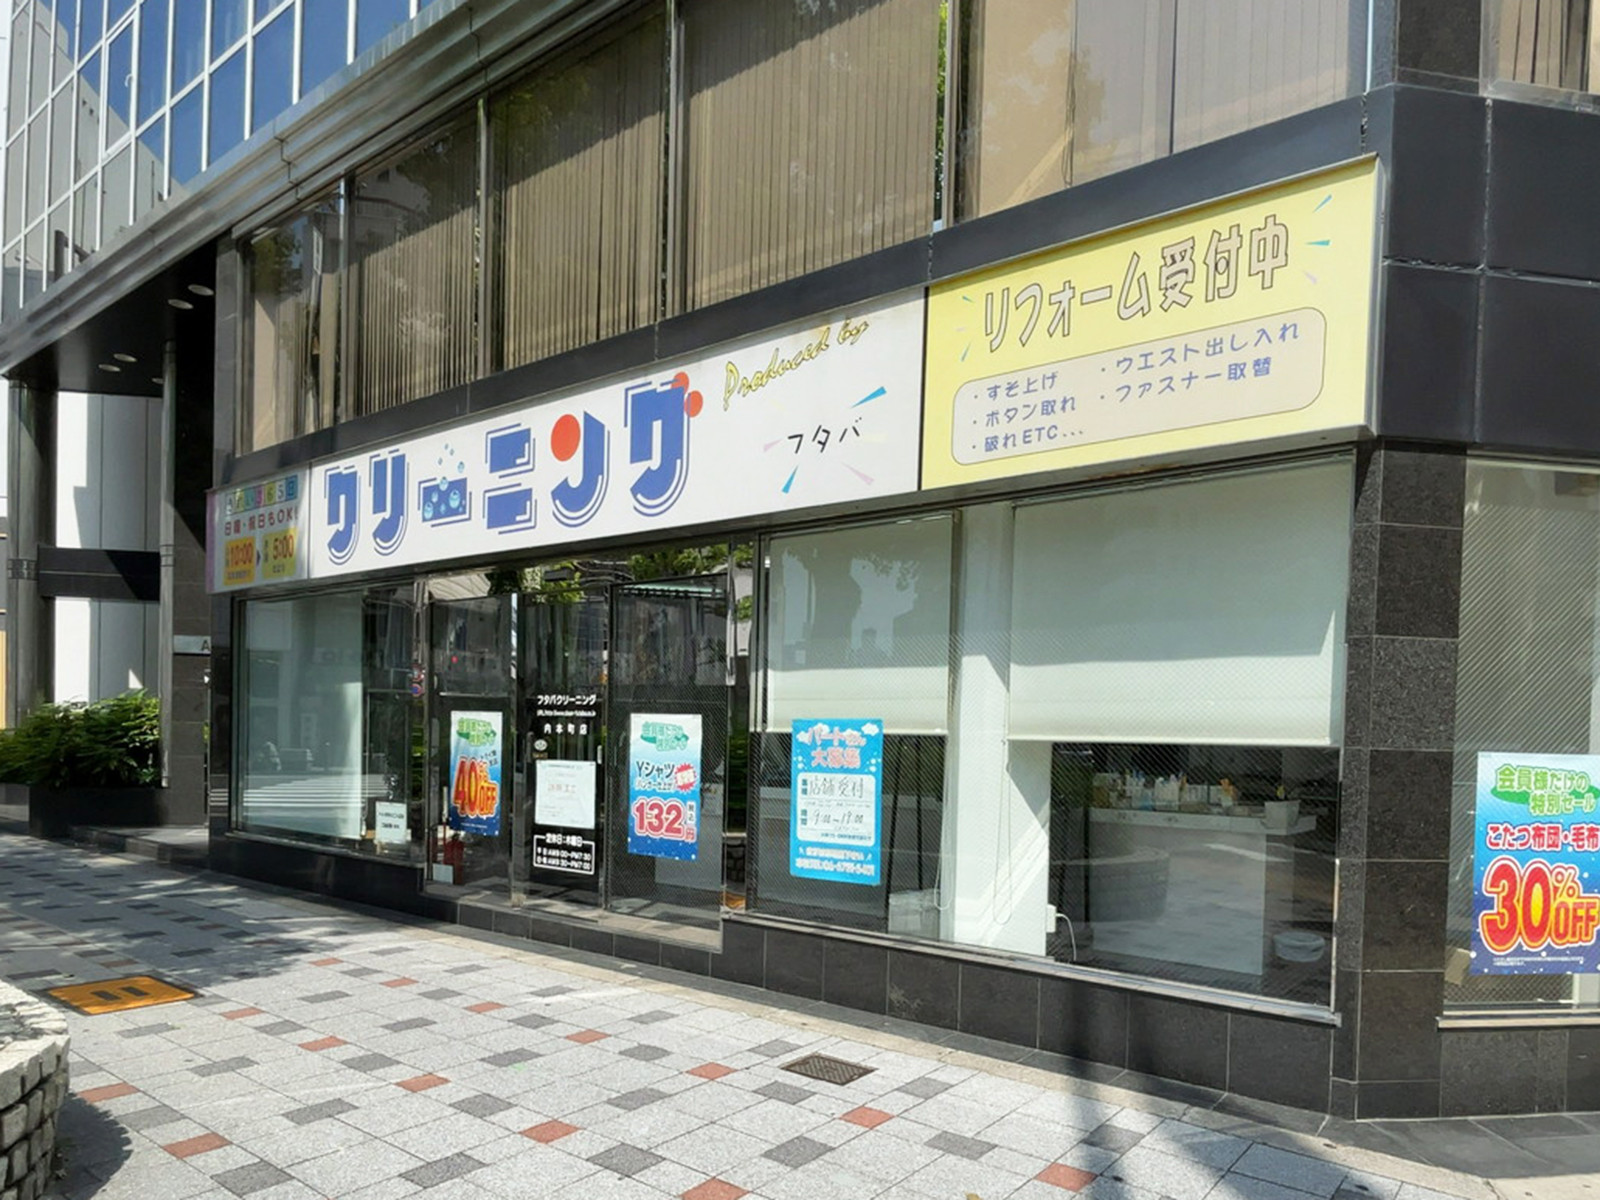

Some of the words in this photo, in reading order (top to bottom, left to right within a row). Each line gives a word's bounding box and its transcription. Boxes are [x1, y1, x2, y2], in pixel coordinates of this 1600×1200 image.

[984, 214, 1289, 353] リフォーム受付中
[723, 327, 831, 411] Produced
[787, 417, 862, 454] フタバ
[325, 372, 703, 565] クリーニング
[537, 694, 597, 706] フタバクリーニング
[636, 761, 675, 778] Yシャツ
[1498, 766, 1588, 791] 会員様だけの
[1530, 792, 1596, 814] 特別セール
[636, 802, 682, 835] 132
[1488, 825, 1600, 850] こたつ布団・毛布
